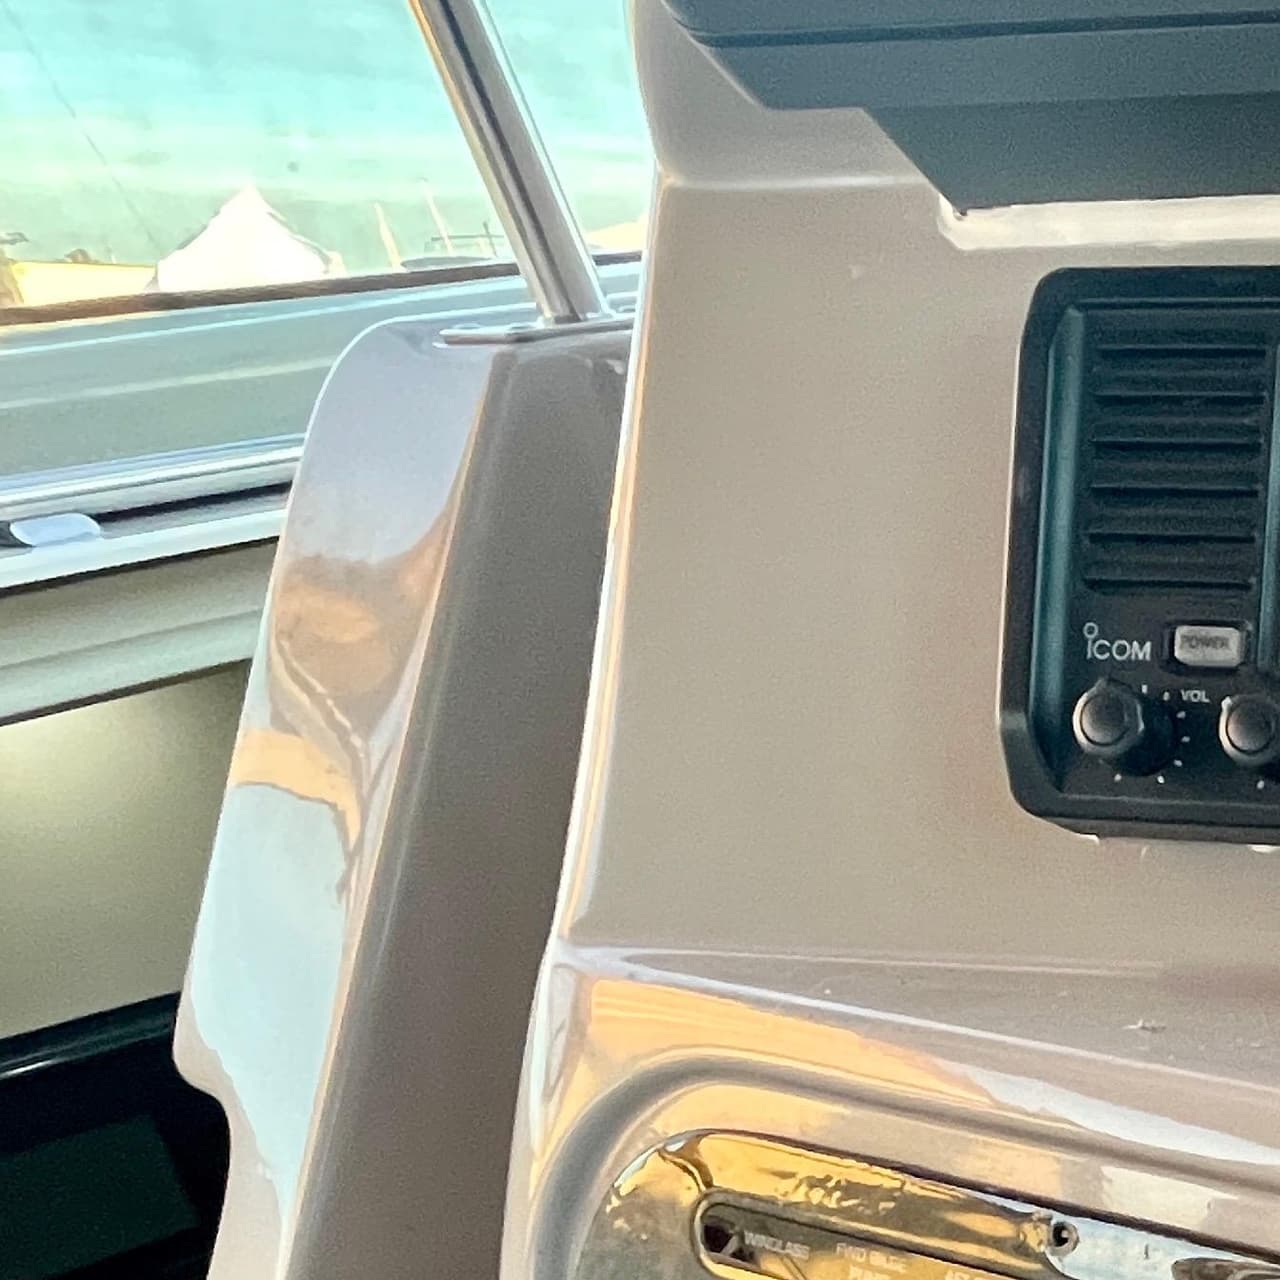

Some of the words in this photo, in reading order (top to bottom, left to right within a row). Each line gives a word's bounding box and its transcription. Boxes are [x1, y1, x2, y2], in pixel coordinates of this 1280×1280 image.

[1181, 690, 1210, 703] VOL
[744, 1231, 810, 1261] WINDLASS
[836, 1243, 867, 1264] FWD
[868, 1250, 906, 1273] BILGE
